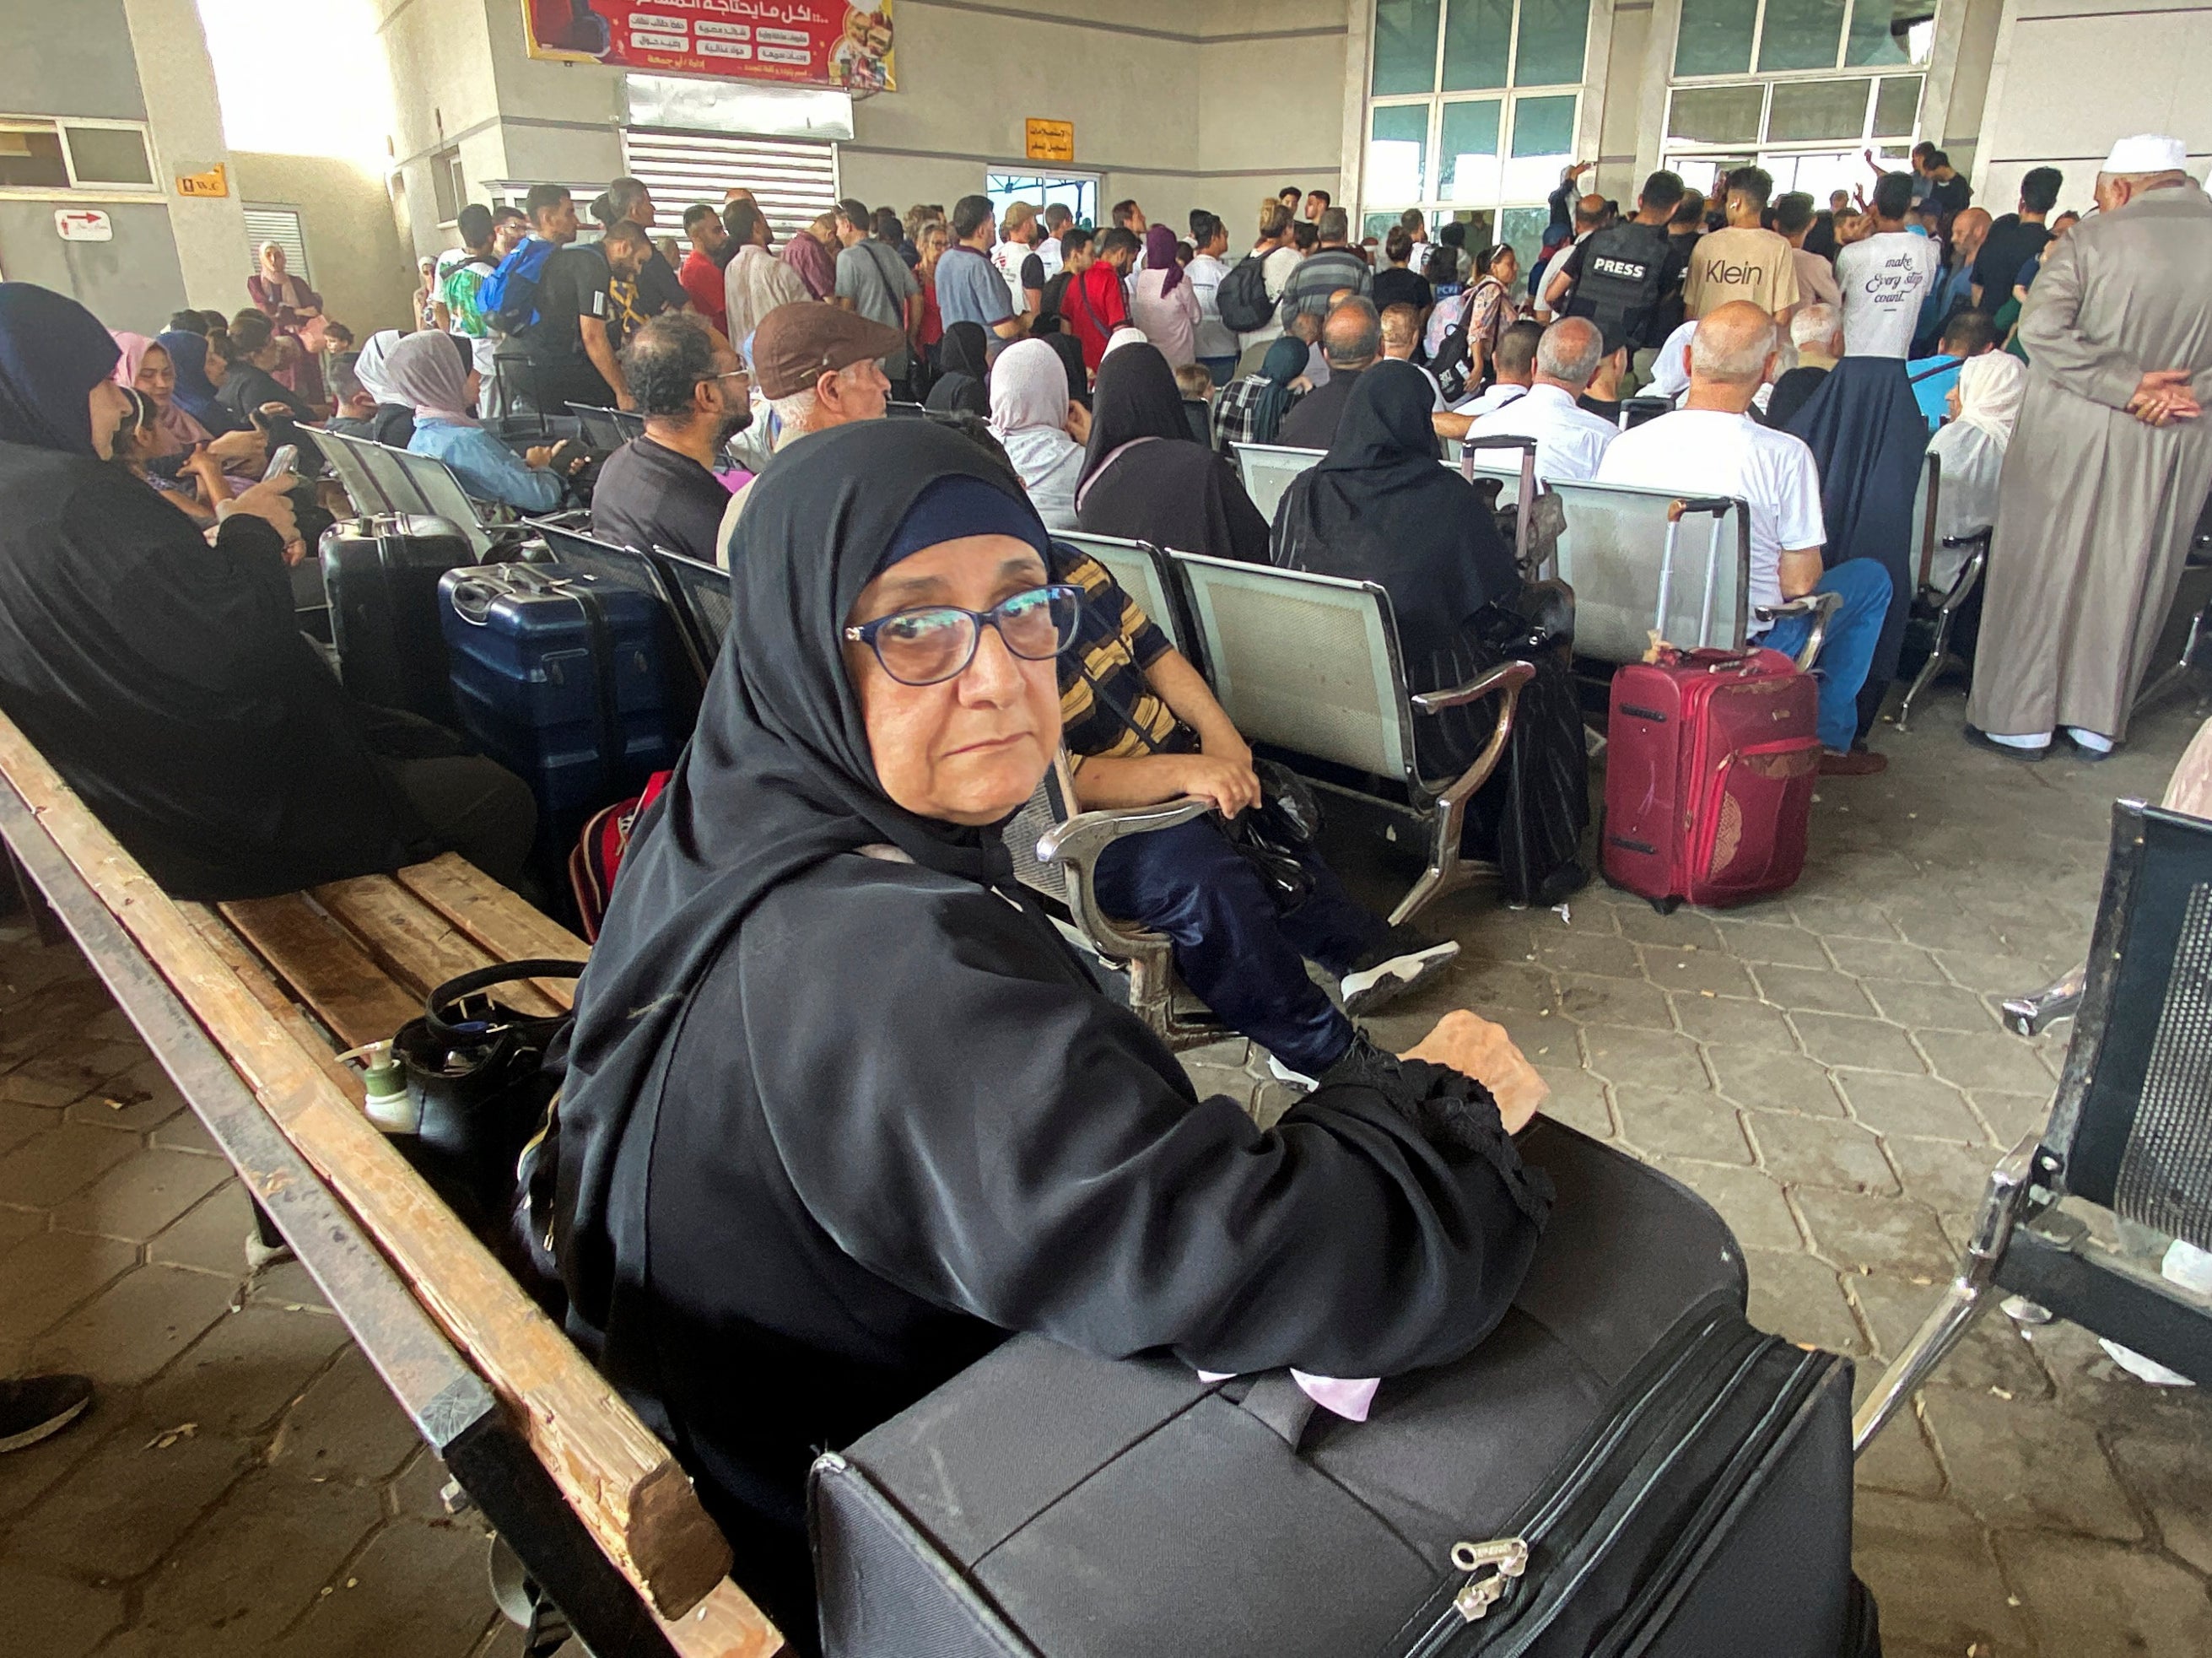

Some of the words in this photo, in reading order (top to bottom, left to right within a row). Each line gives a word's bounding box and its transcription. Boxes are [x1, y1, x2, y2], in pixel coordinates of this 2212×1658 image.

[781, 4, 811, 24] لكل
[1593, 257, 1645, 278] PRESS
[1706, 259, 1762, 285] Klein
[1885, 252, 1913, 271] make
[1865, 273, 1902, 293] Every
[1904, 271, 1923, 289] step
